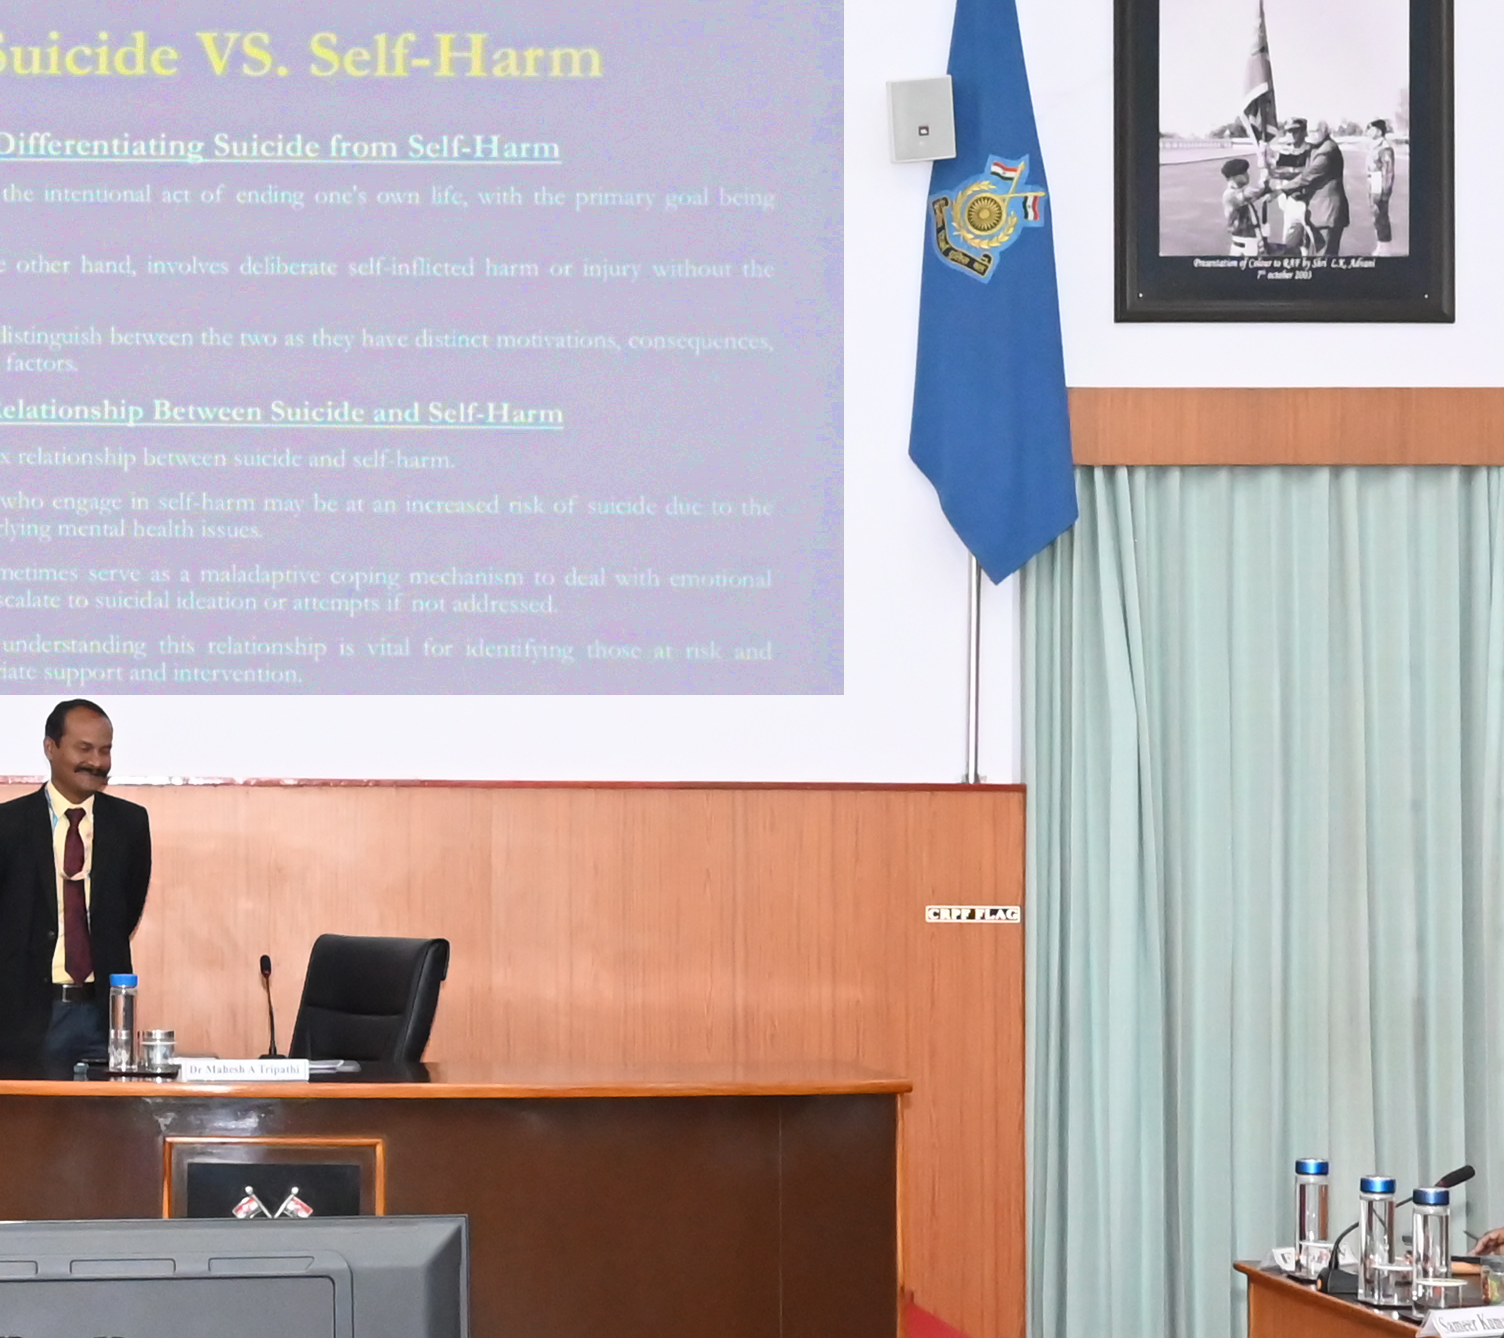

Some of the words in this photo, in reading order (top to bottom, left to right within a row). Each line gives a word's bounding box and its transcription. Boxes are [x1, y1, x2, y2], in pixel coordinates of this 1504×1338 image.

[195, 31, 289, 78] VS.
[309, 32, 603, 79] Self-Harm
[214, 133, 320, 159] Suicide
[330, 133, 398, 159] from
[408, 134, 560, 160] Self-Harm
[1, 183, 35, 202] the
[43, 183, 152, 203] intentional
[161, 184, 192, 203] act
[199, 184, 224, 203] of
[235, 185, 305, 210] ending
[314, 185, 368, 204] one's
[375, 191, 422, 205] own
[477, 186, 524, 205] with
[532, 186, 567, 206] the
[574, 187, 656, 212] primary
[664, 187, 710, 212] goal
[719, 187, 777, 213] being
[15, 254, 73, 274] other
[146, 255, 230, 275] involves
[238, 256, 338, 276] deliberate
[347, 257, 476, 277] self-inflicted
[484, 258, 540, 277] harm
[548, 264, 574, 277] or
[581, 258, 641, 284] injury
[650, 259, 734, 278] without
[741, 259, 777, 279] the
[1294, 270, 1313, 279] 2003
[153, 399, 262, 422] Between
[271, 400, 365, 423] Suicide
[373, 402, 420, 424] and
[428, 402, 564, 425] Self-Harm
[927, 908, 971, 920] CRPF
[975, 908, 1019, 920] FLAG
[190, 1065, 202, 1074] Dr
[206, 1065, 245, 1074] Mahesh
[248, 1065, 256, 1074] A
[260, 1065, 300, 1076] Tripathi
